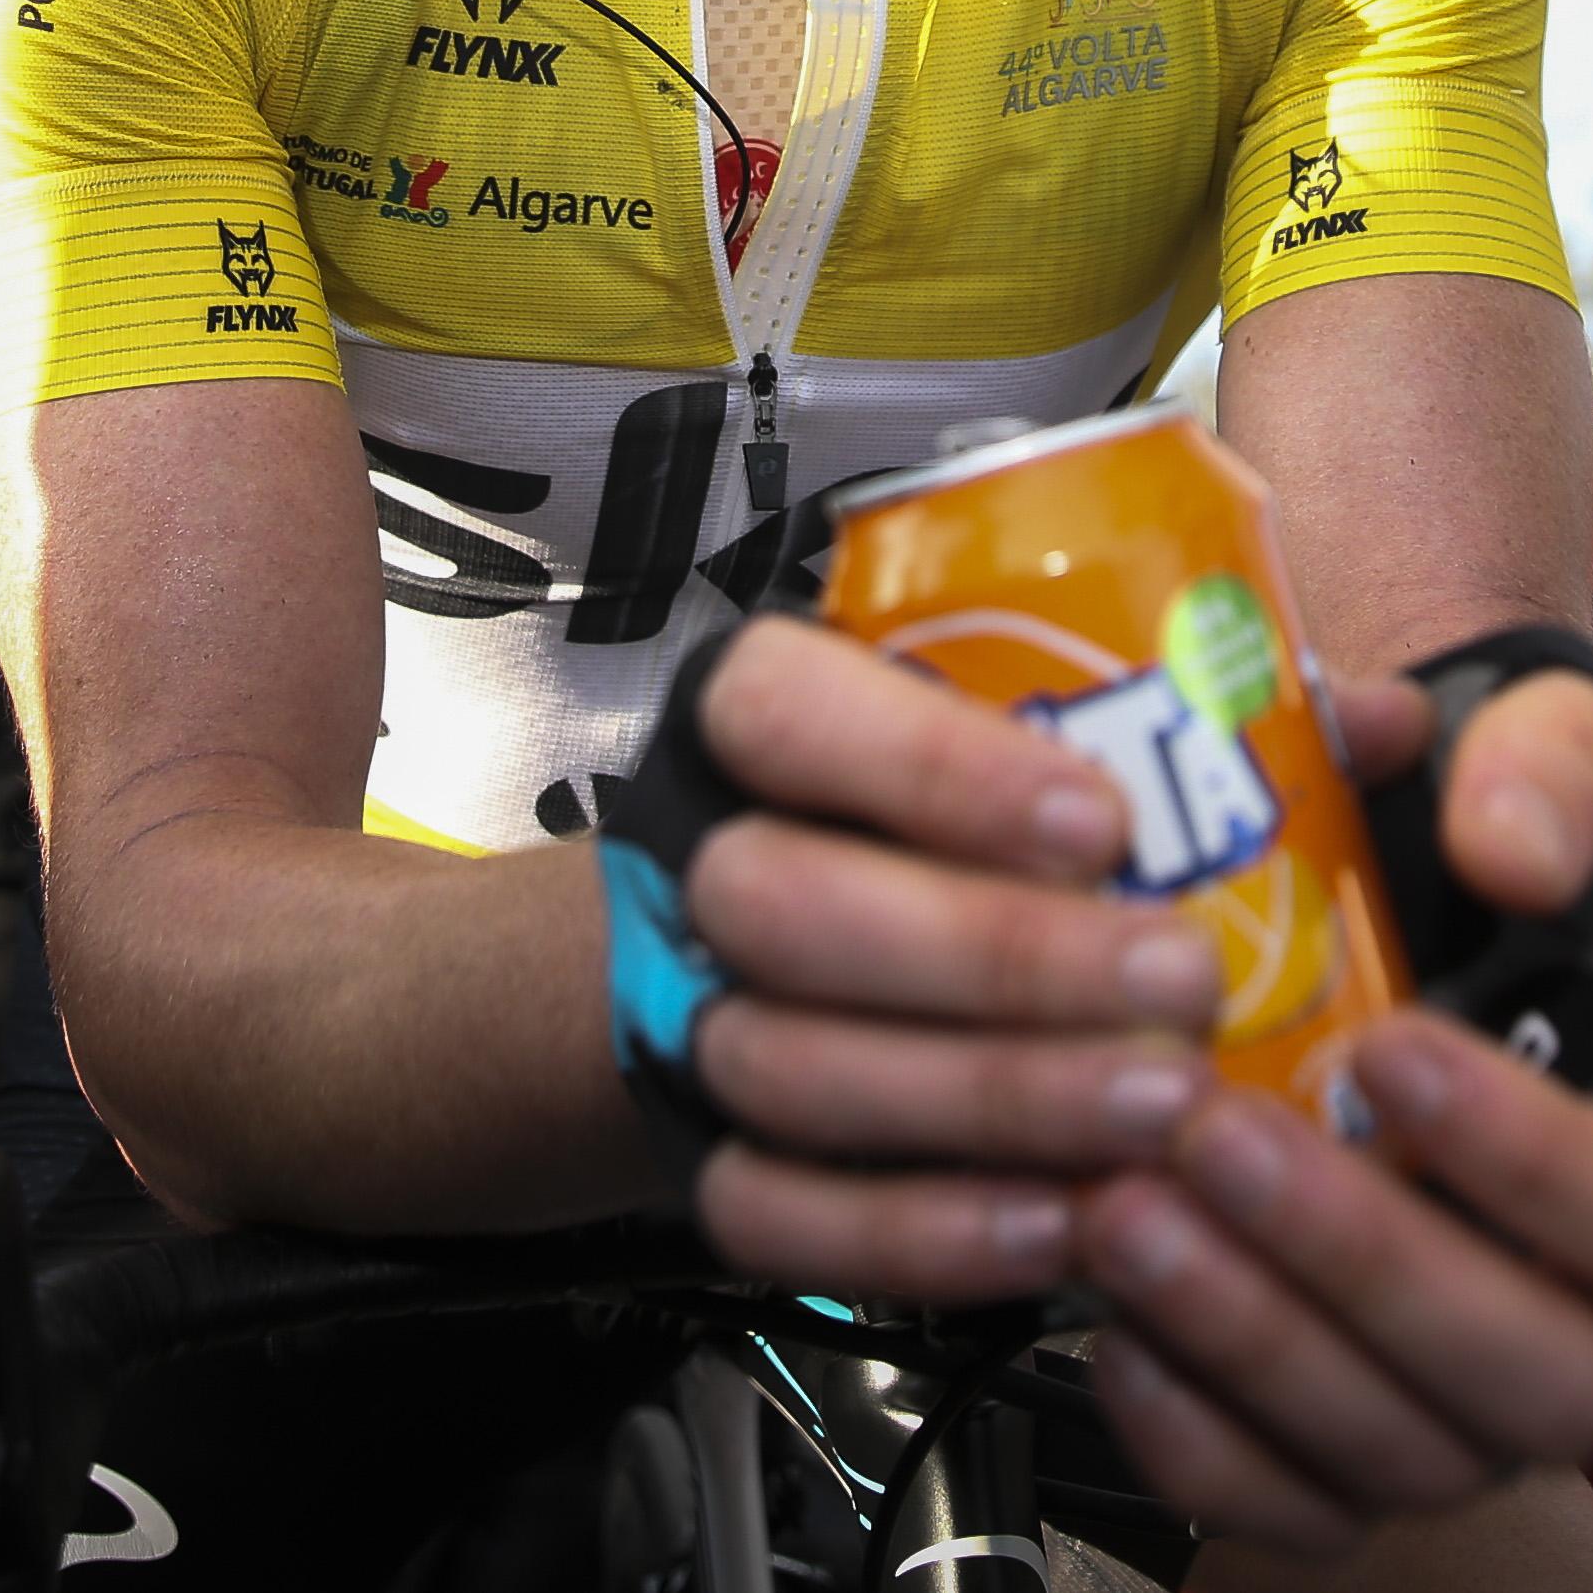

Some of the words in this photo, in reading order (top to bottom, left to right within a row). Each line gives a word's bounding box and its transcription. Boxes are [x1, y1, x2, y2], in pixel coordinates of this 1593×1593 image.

[1047, 23, 1168, 69] VOLTA
[1001, 57, 1168, 118] ALGARVE
[350, 150, 374, 172] DE
[467, 176, 655, 234] Algarve
